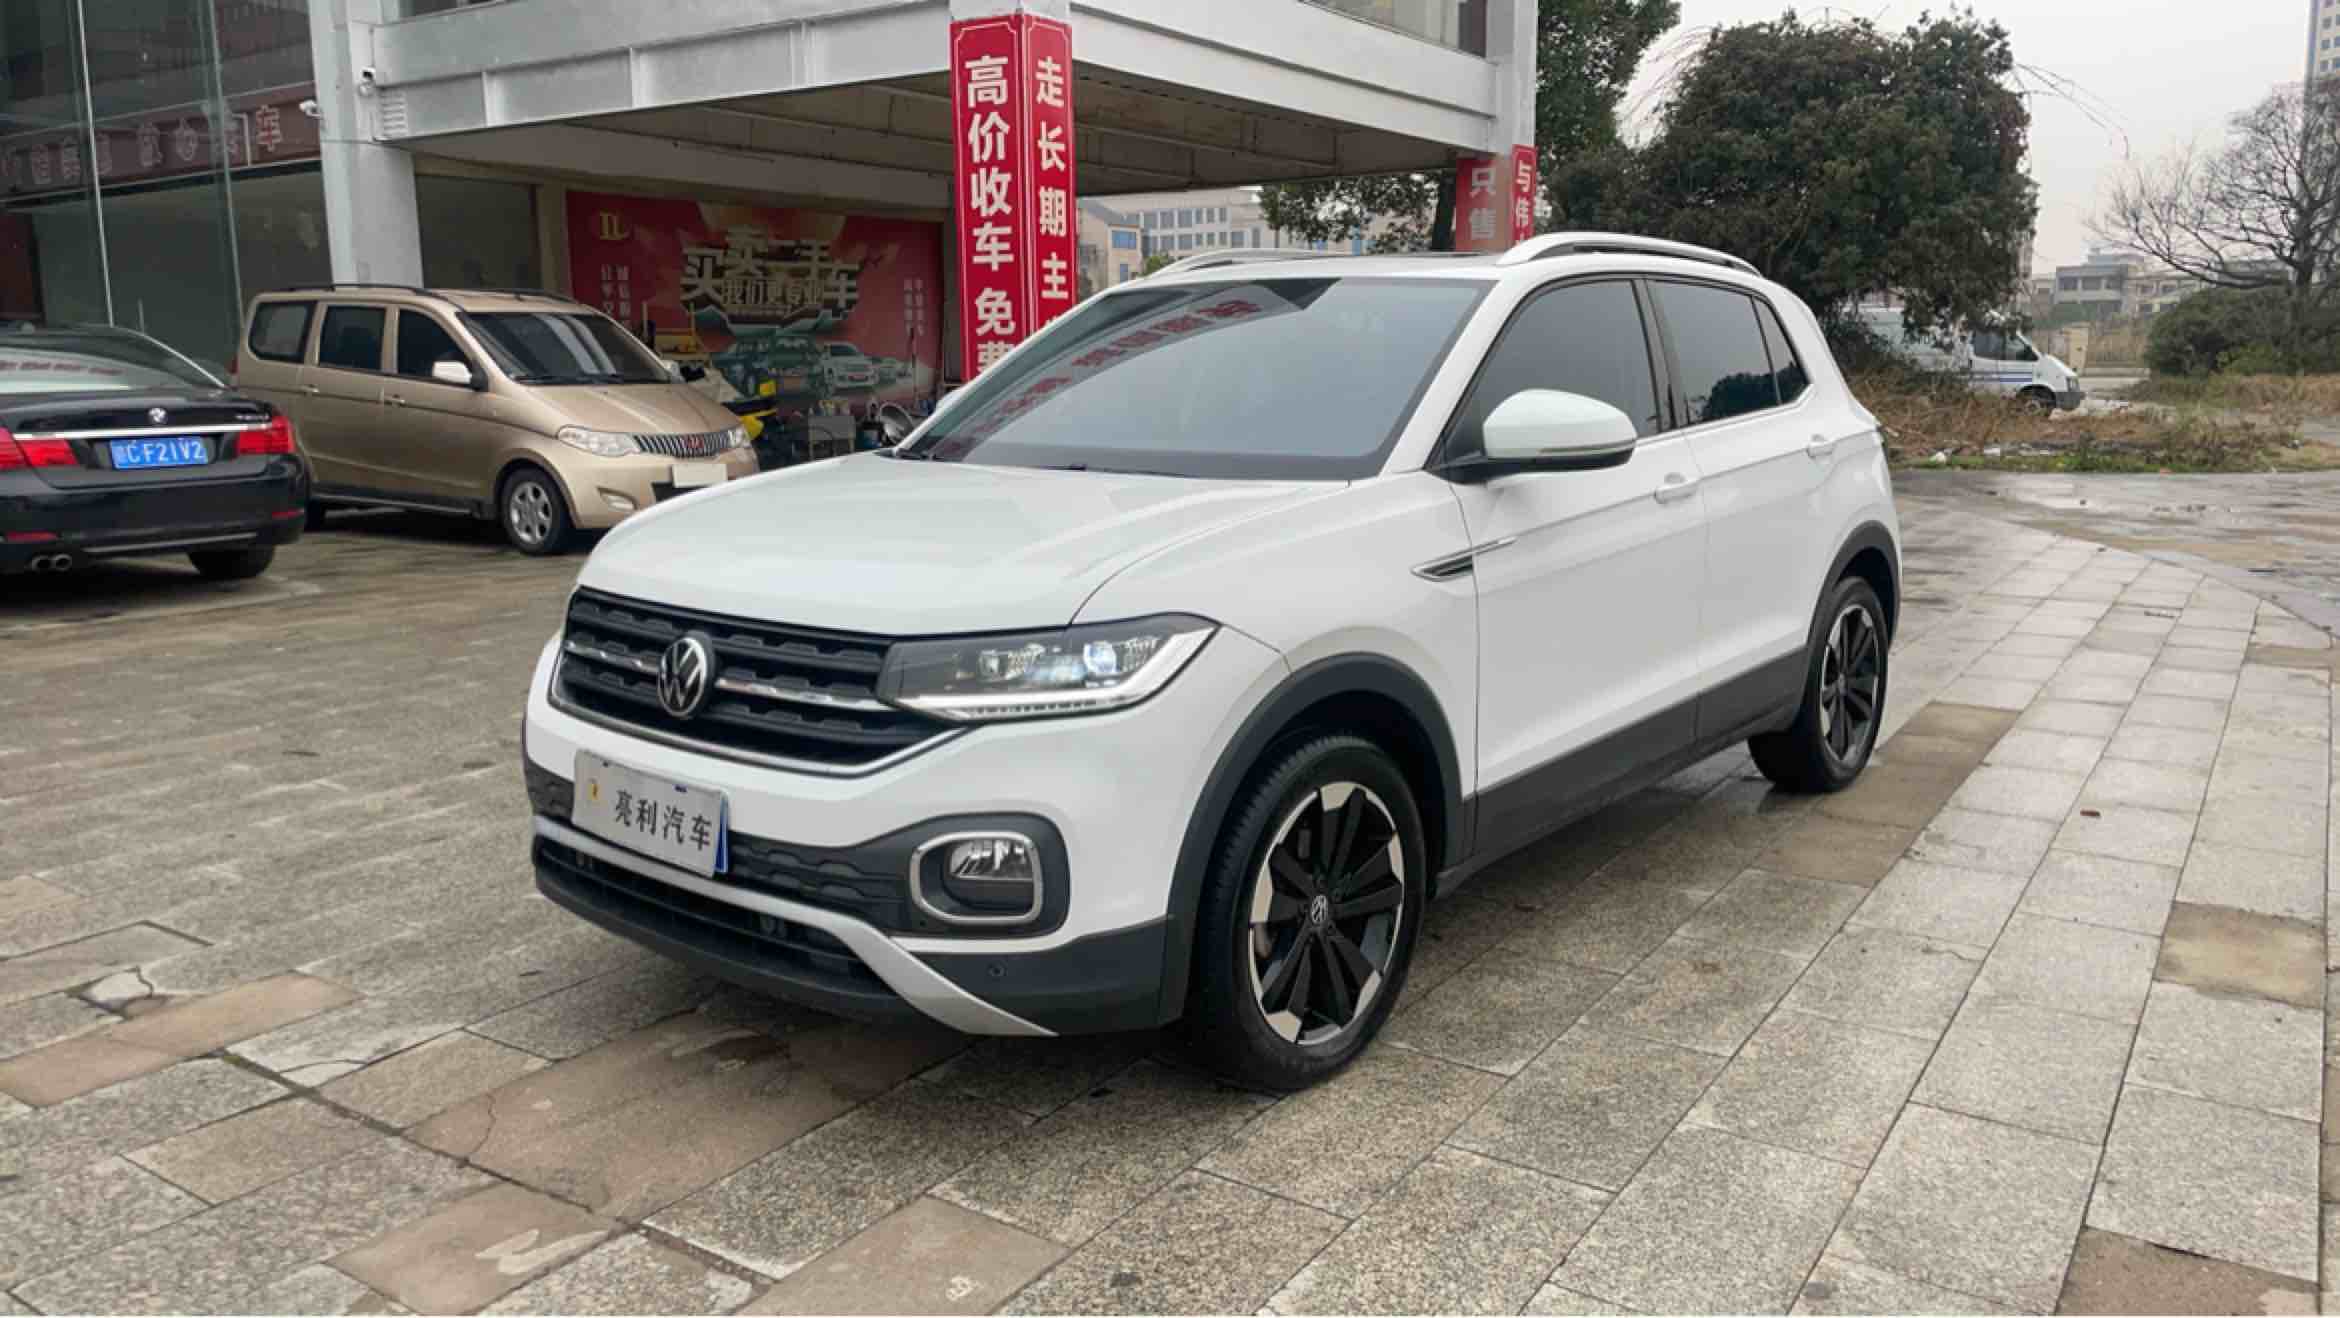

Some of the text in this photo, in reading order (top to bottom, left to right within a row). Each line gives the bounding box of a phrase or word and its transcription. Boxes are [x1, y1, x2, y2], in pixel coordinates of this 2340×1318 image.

[1035, 55, 1069, 328] 走长期主
[615, 789, 713, 852] 亮利汽车
